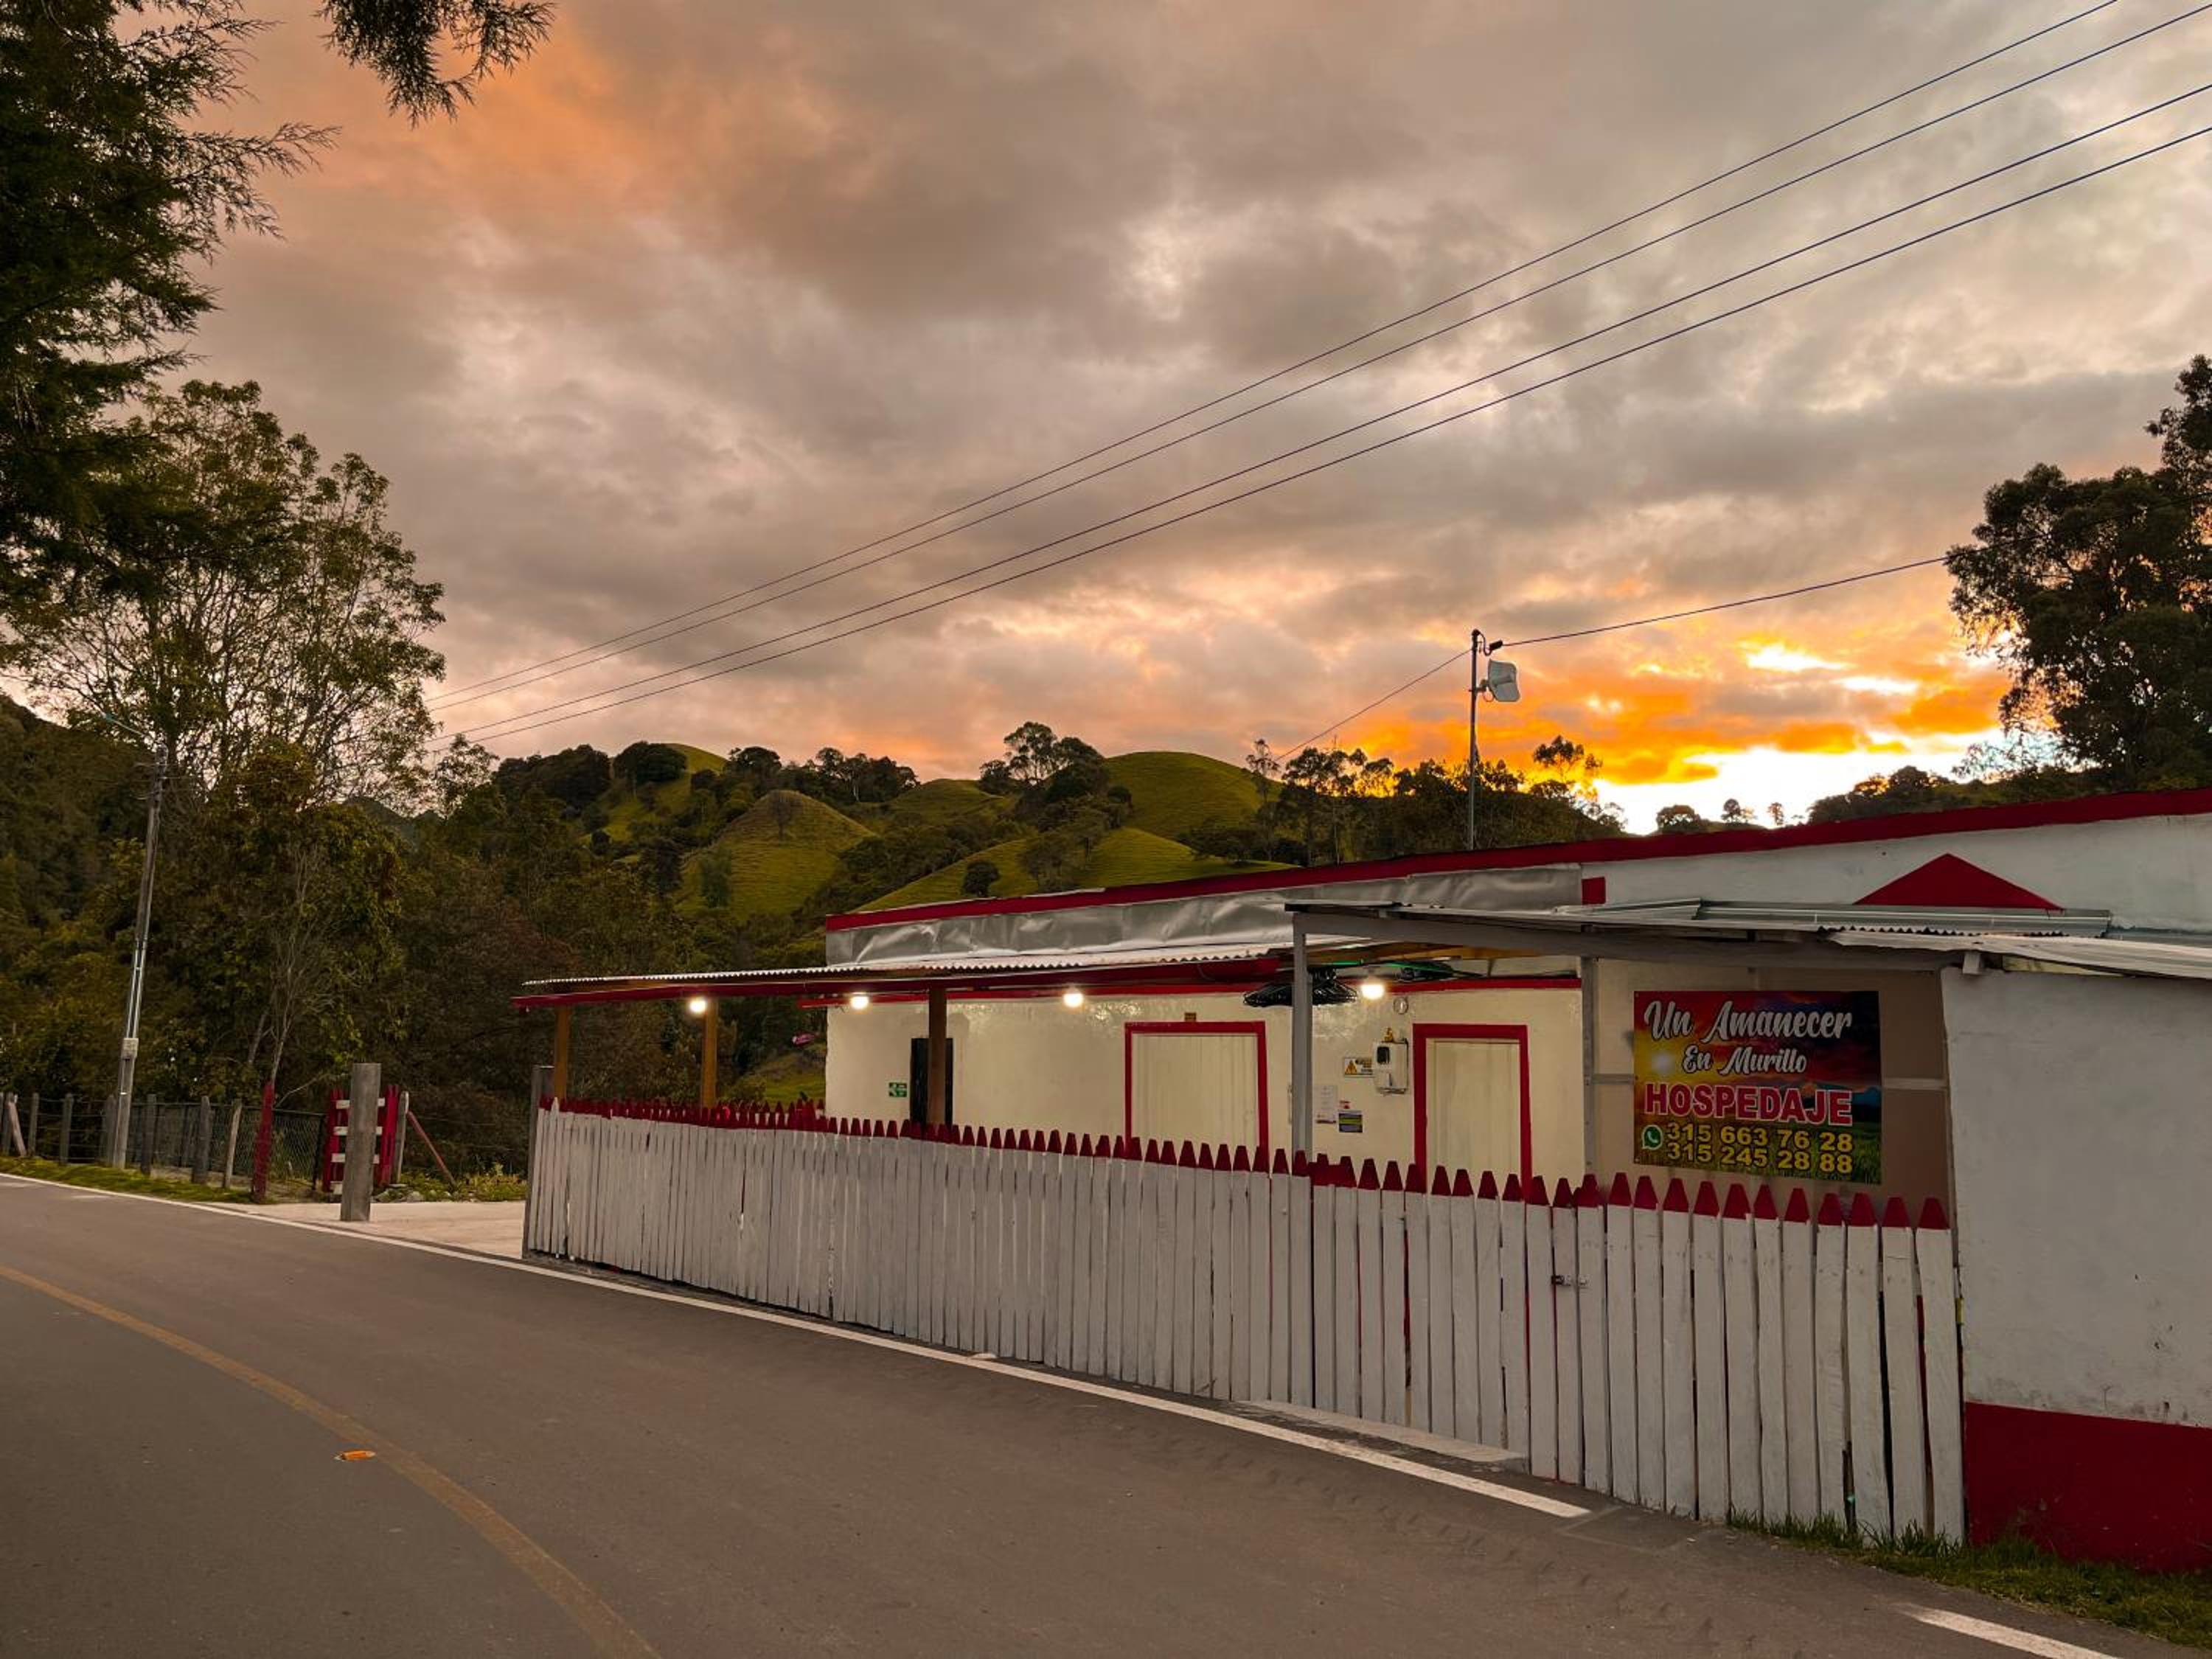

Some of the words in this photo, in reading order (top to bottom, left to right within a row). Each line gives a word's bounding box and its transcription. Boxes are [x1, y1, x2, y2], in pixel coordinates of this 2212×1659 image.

[1644, 1001, 1693, 1040] Un
[1700, 1001, 1853, 1043] Amanecer
[1683, 1045, 1712, 1074] En
[1718, 1046, 1807, 1075] Murillo
[1644, 1082, 1853, 1126] HOSPEDAJE
[1666, 1122, 1711, 1142] 315
[1720, 1126, 1768, 1146] 663
[1778, 1130, 1810, 1150] 76
[1820, 1133, 1853, 1152] 28
[1667, 1142, 1712, 1162] 315
[1721, 1146, 1768, 1167] 245
[1778, 1150, 1810, 1170] 28
[1820, 1153, 1853, 1174] 88
